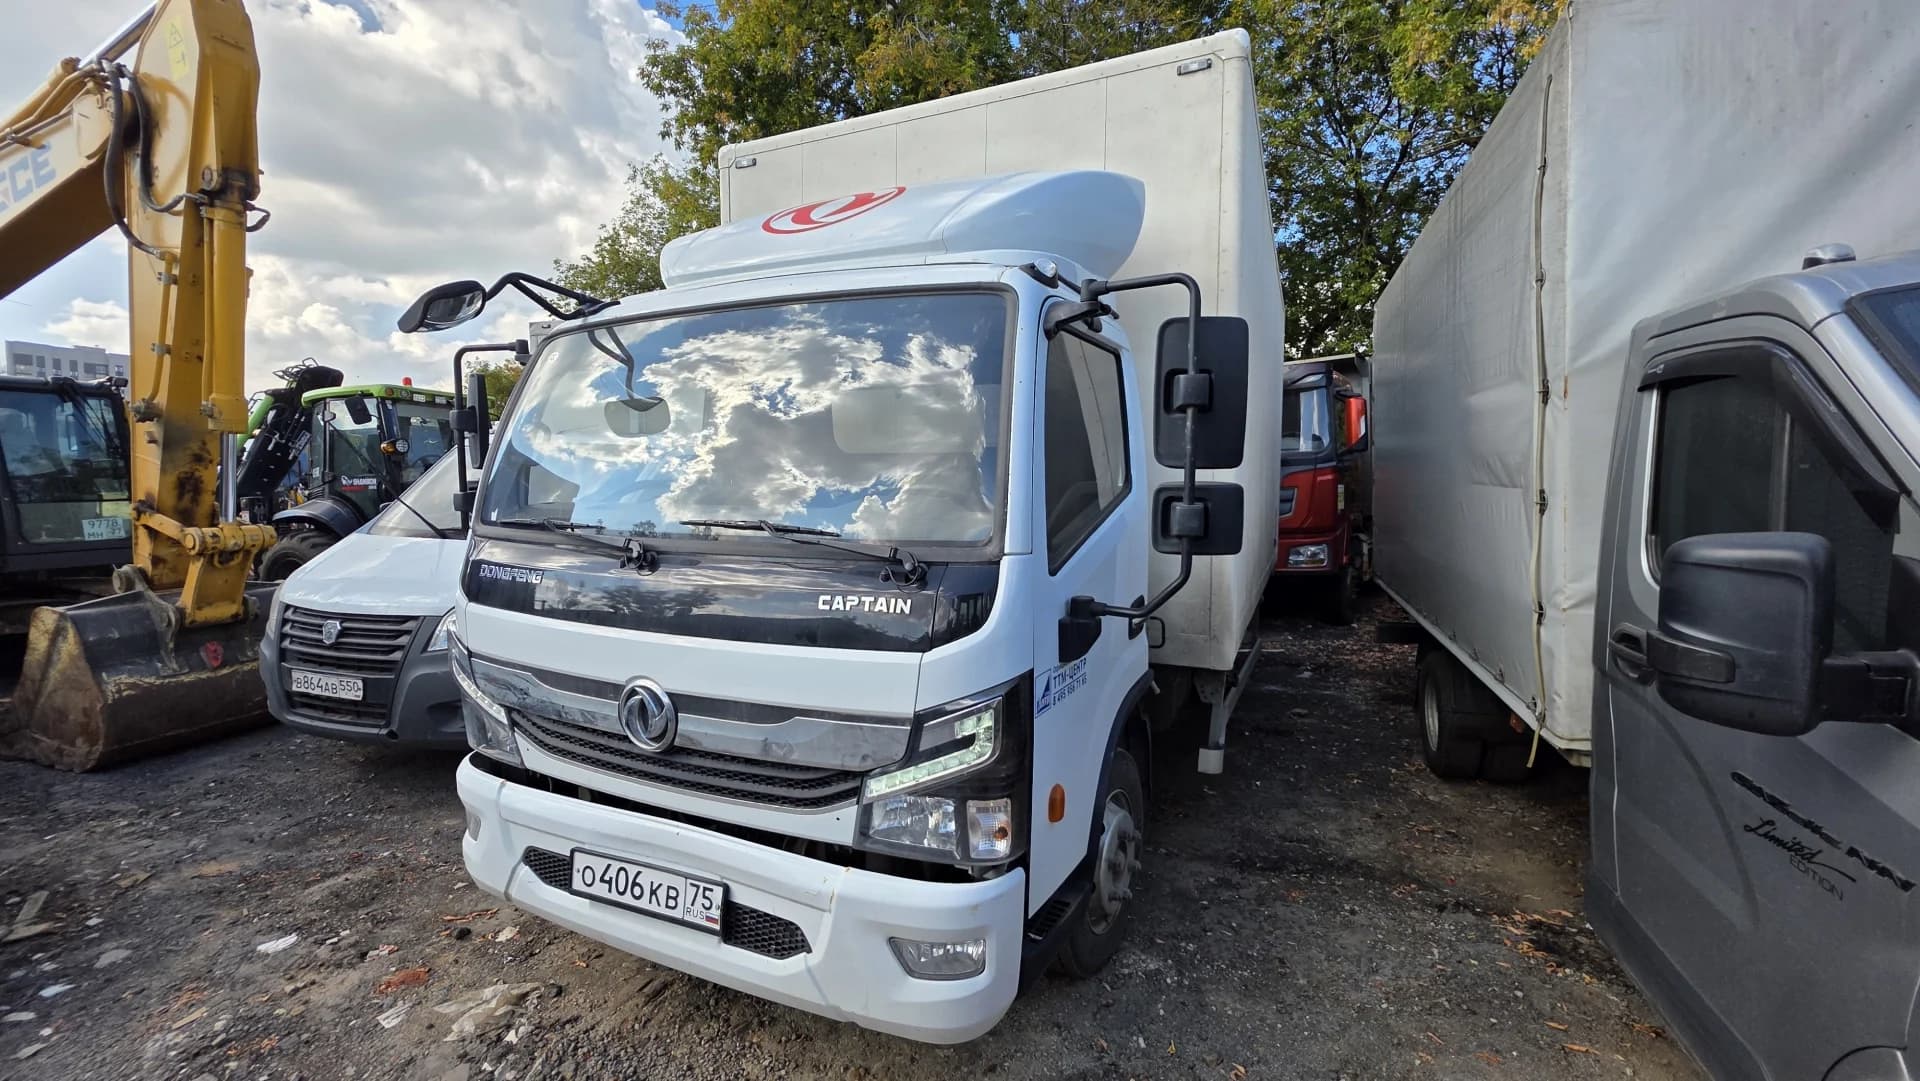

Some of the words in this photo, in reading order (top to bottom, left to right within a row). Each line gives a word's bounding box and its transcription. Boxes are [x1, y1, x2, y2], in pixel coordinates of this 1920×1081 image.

[479, 564, 544, 584] DONGFENG
[817, 594, 912, 615] CAPTAIN
[1743, 817, 1857, 883] Limited
[1790, 853, 1844, 901] EDITION
[688, 883, 714, 911] 75
[685, 906, 705, 920] RUS
